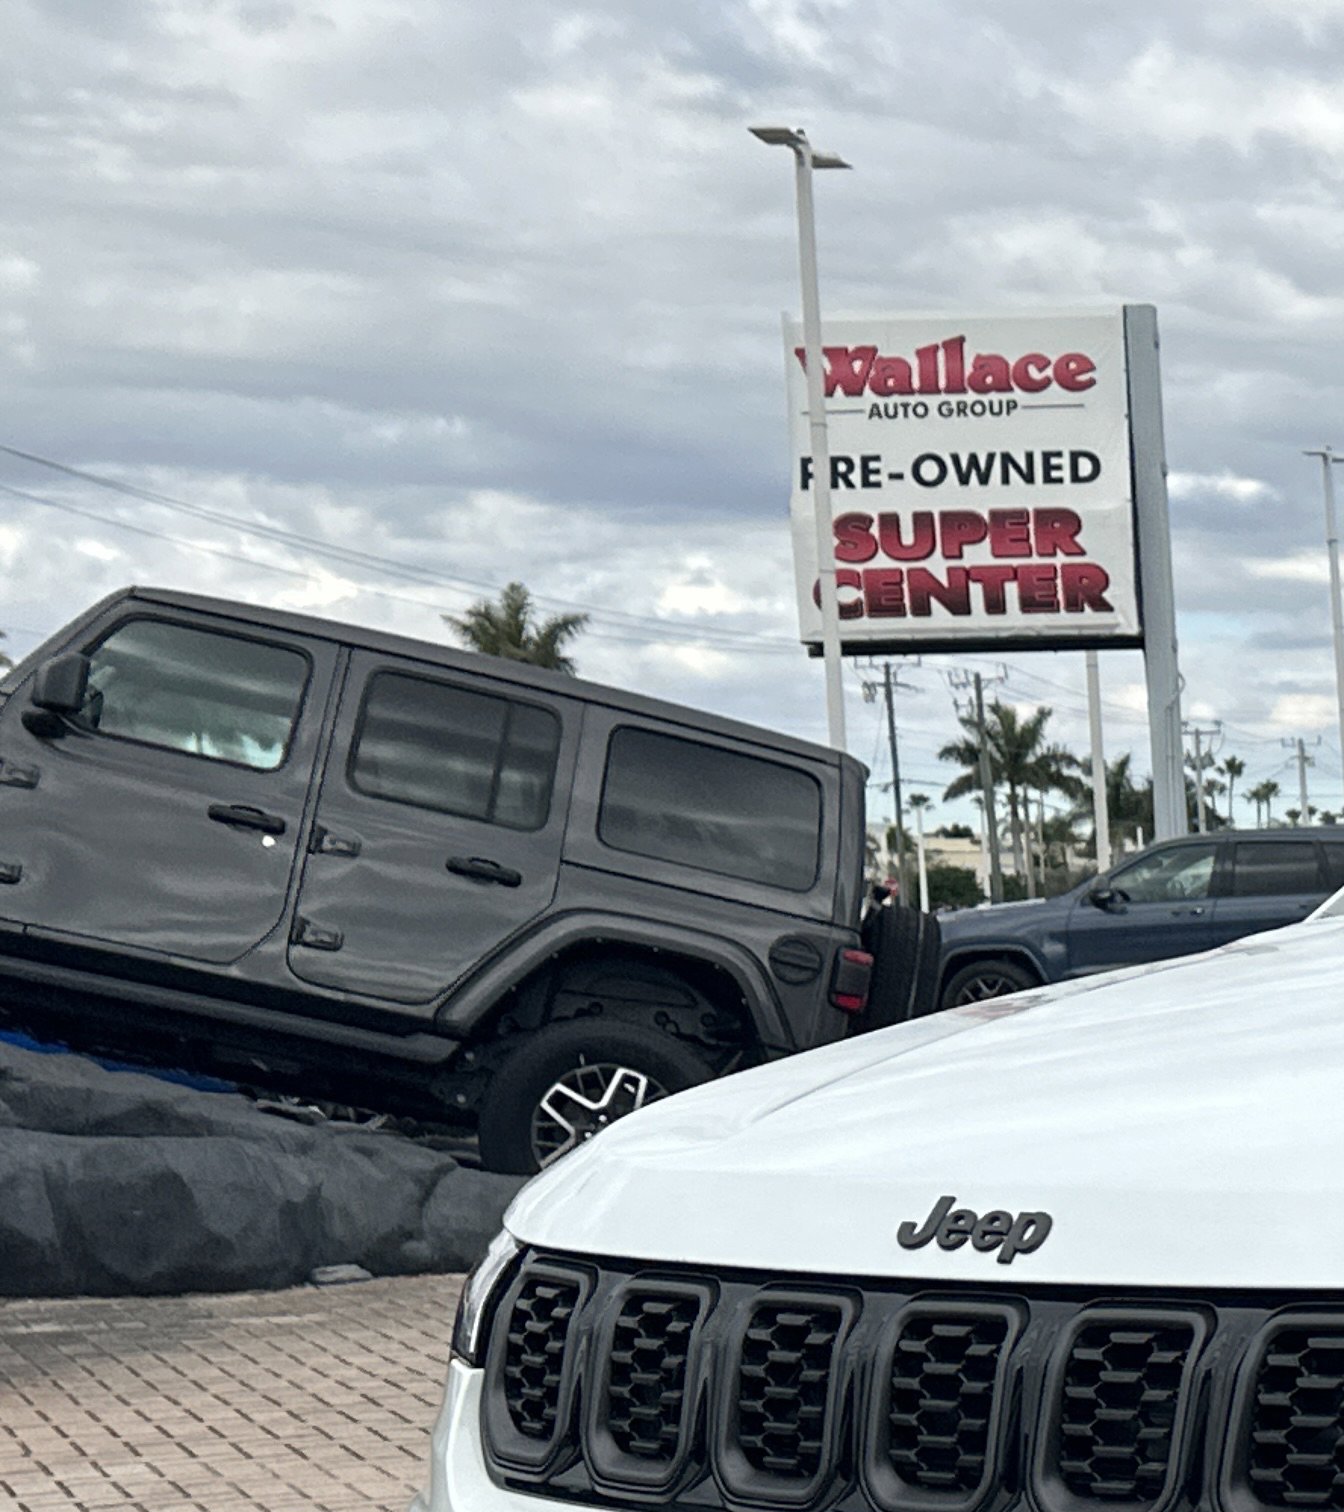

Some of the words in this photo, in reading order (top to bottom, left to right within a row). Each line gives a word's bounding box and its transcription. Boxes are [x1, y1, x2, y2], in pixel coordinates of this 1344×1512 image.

[795, 335, 1097, 398] Wallace
[867, 401, 930, 421] AUTO
[936, 398, 1019, 418] GROUP
[832, 507, 1088, 564] SUPER
[813, 562, 1115, 621] CENTER
[897, 1196, 1053, 1265] Jeep
